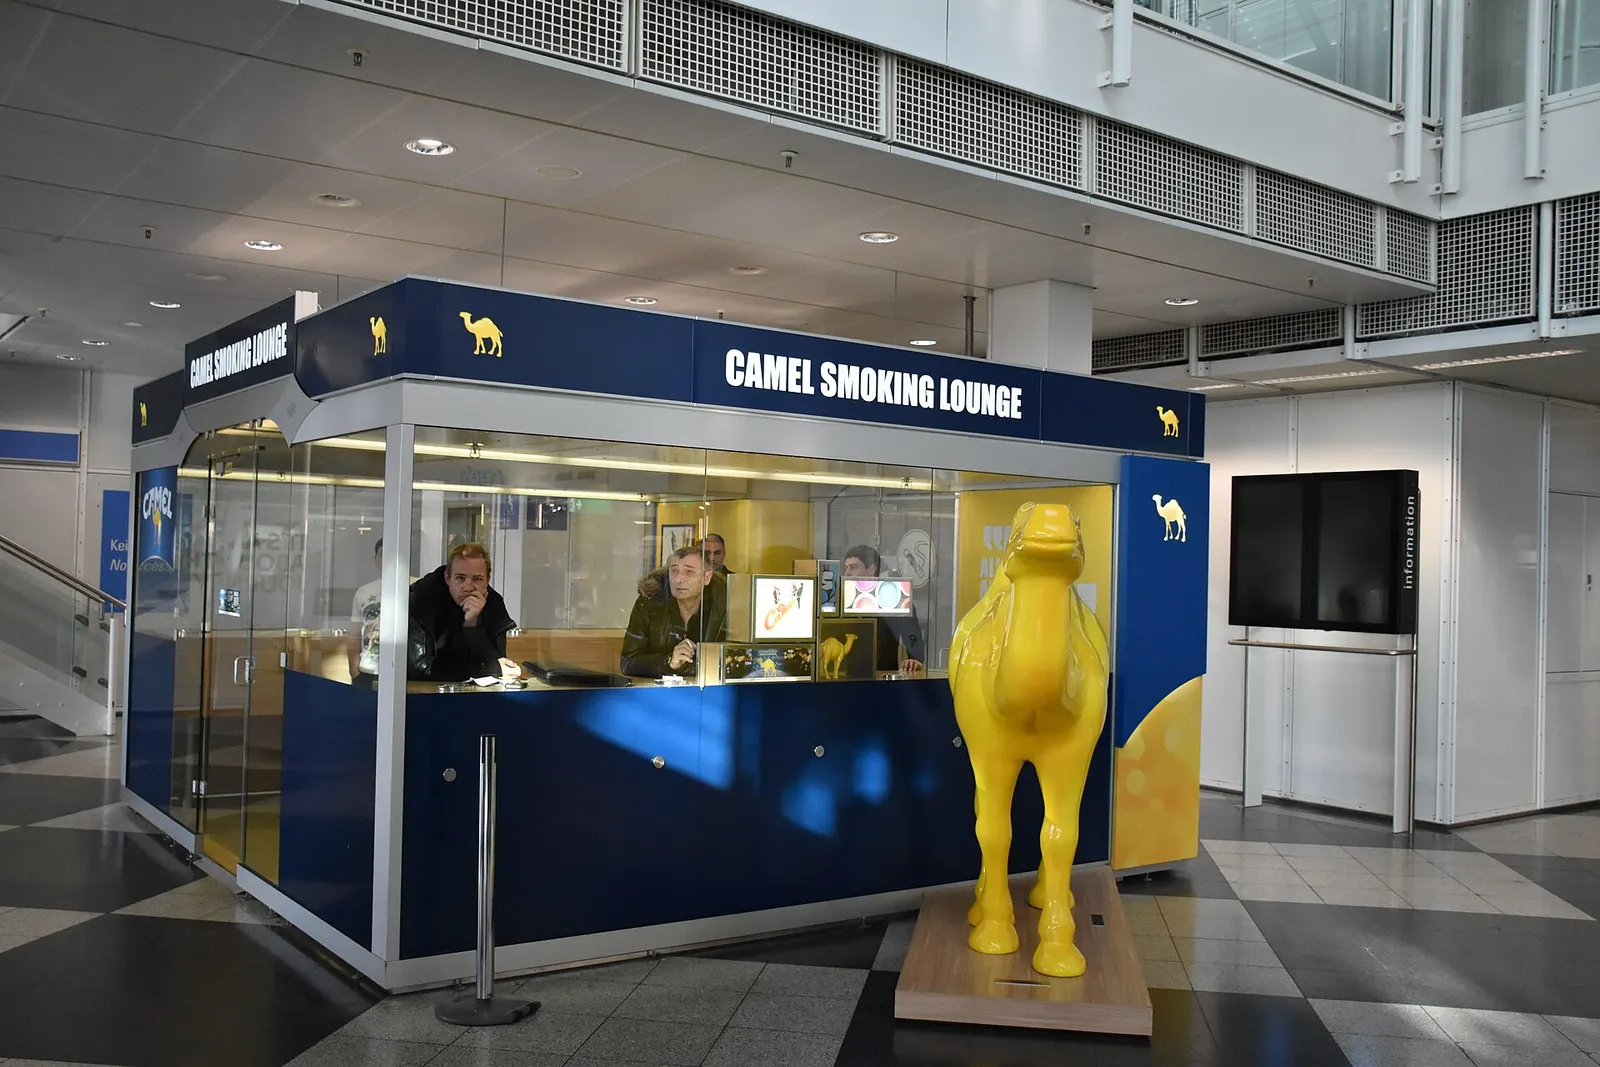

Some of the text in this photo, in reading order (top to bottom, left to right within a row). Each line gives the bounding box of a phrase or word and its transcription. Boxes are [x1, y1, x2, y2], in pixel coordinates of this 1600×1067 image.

[190, 321, 288, 389] CAMEL SMOKING LOUNGE
[725, 348, 1022, 420] CAMEL SMOKING LOUNGE
[142, 486, 173, 520] CAMEL
[109, 558, 127, 572] No
[110, 538, 128, 552] Kei
[1403, 495, 1415, 589] information
